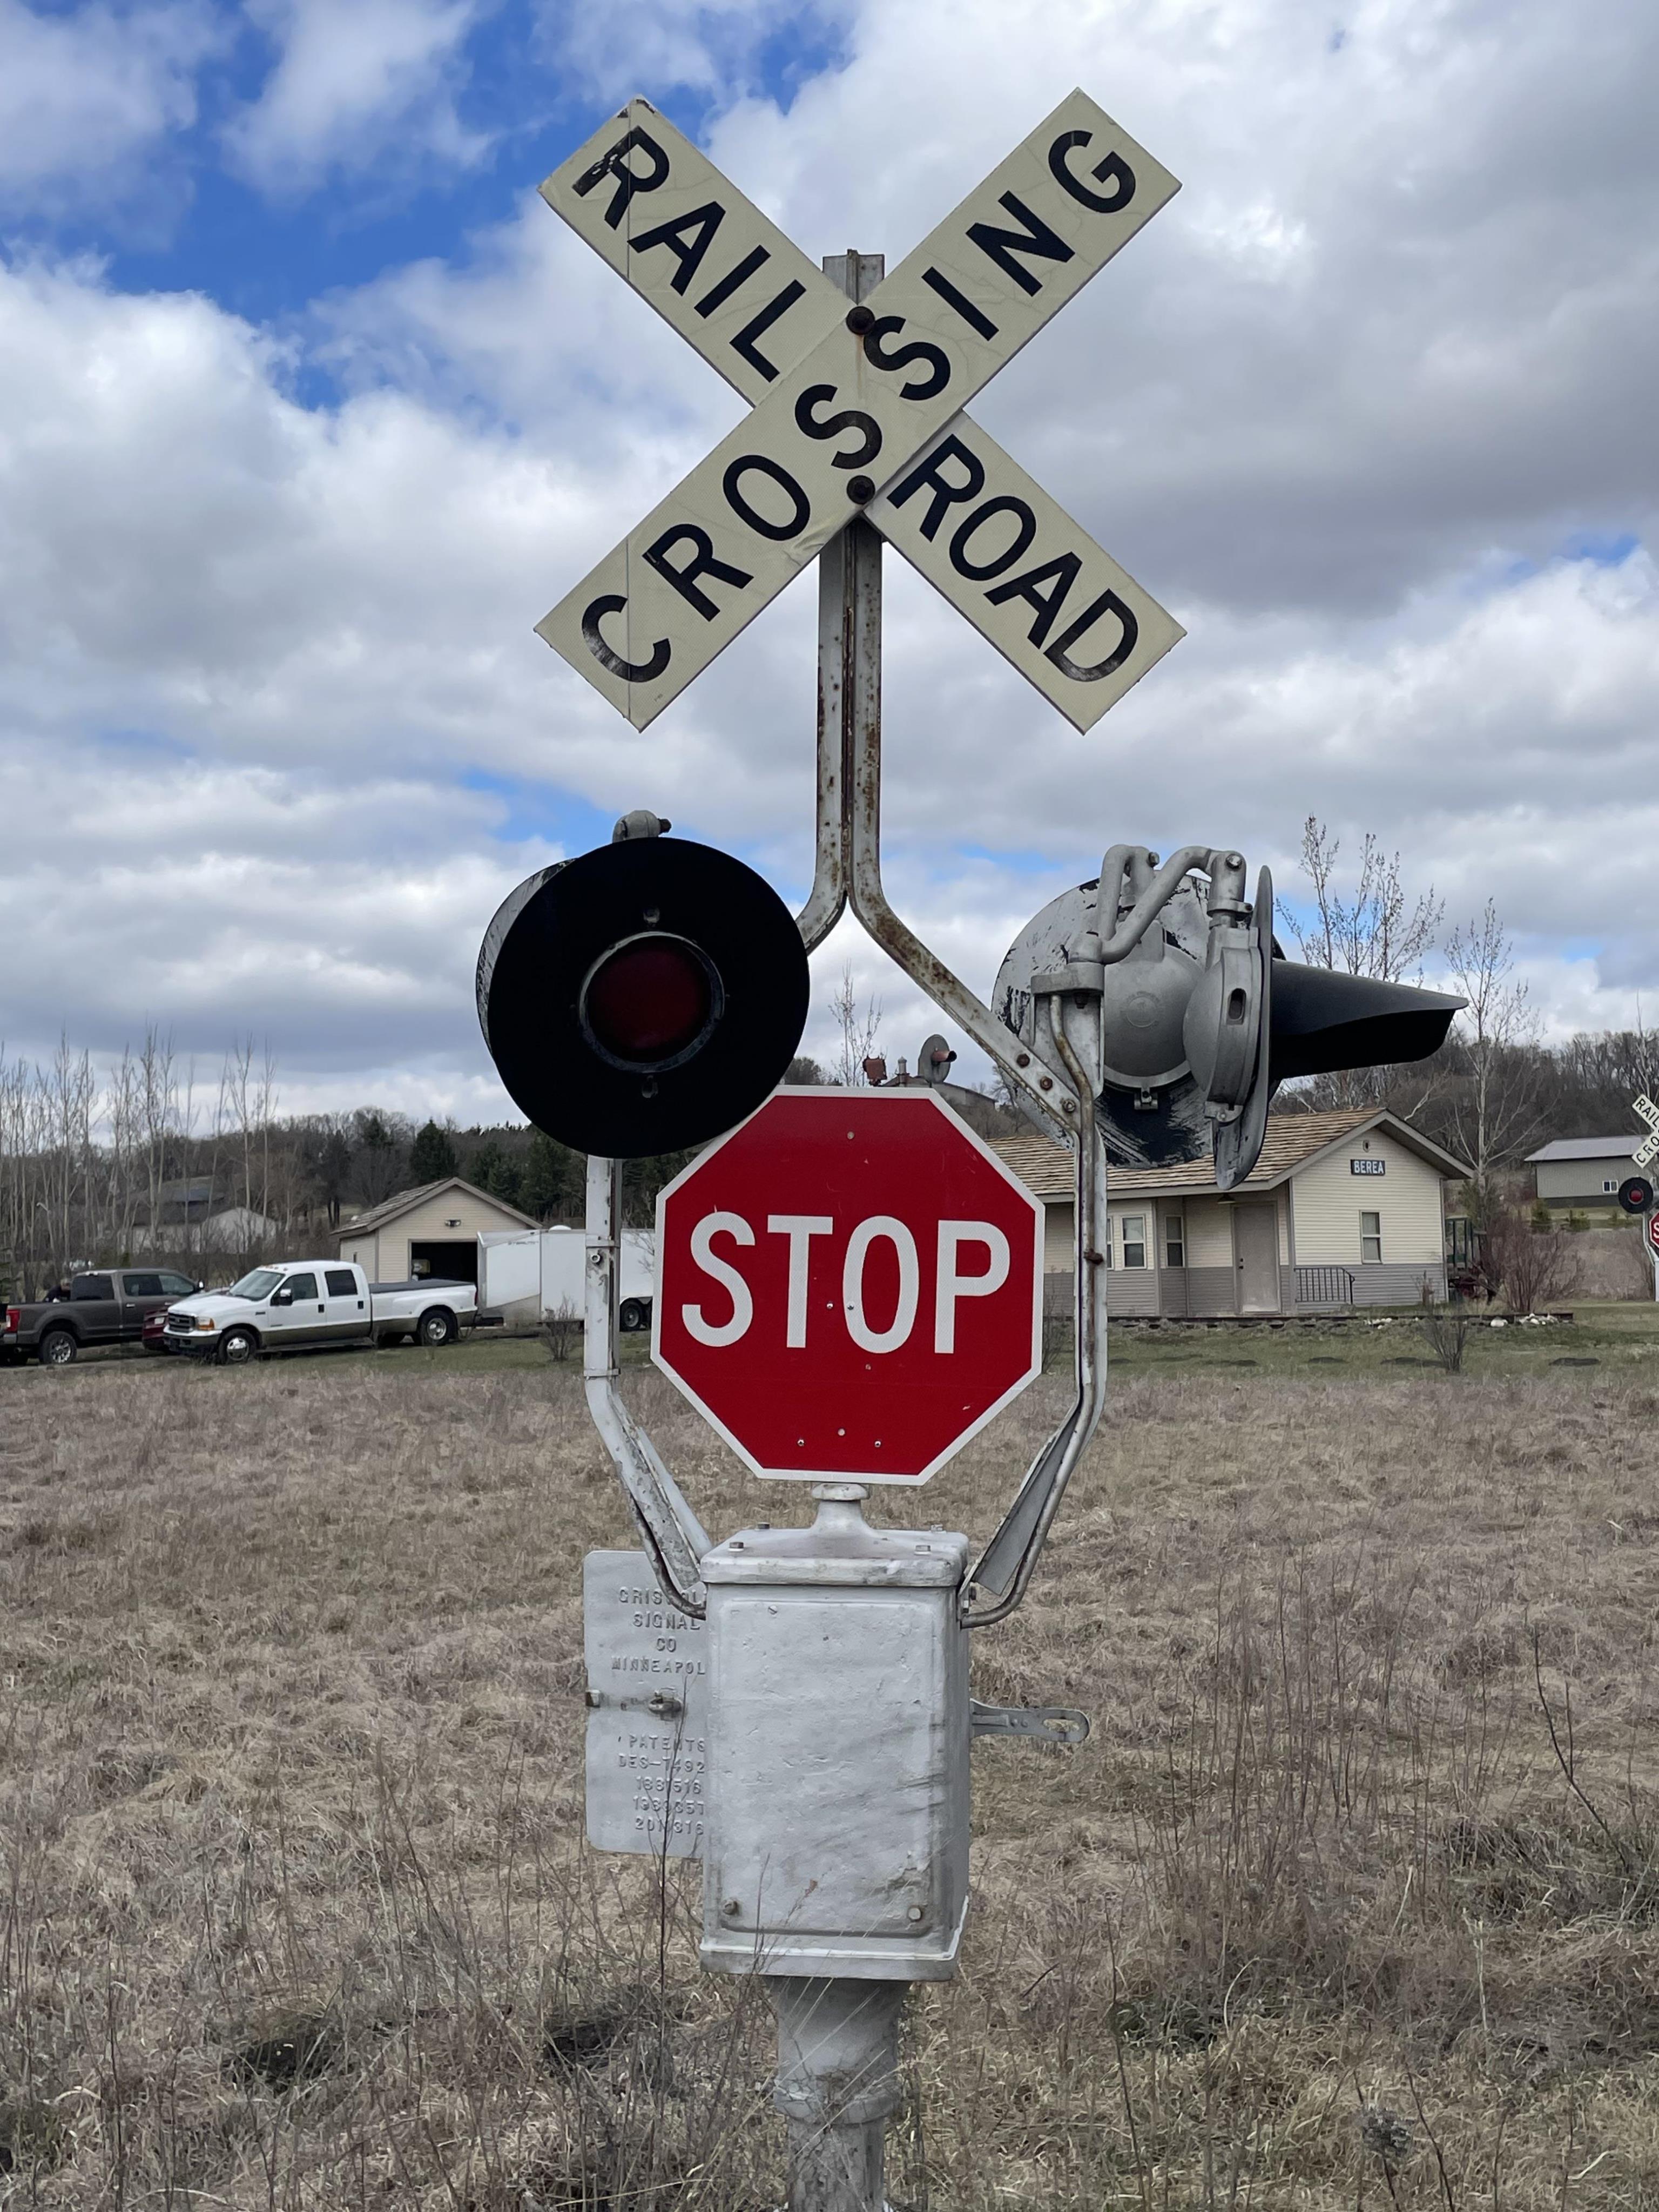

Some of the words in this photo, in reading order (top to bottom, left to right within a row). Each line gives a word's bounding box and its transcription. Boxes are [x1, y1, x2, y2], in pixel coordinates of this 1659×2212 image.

[572, 125, 806, 382] RAIL
[886, 434, 1138, 683] ROAD
[581, 130, 1136, 683] CROSSING
[1636, 1128, 1659, 1163] CRO
[1354, 1161, 1384, 1174] BEREA
[682, 1211, 1010, 1354] STOP
[632, 1610, 701, 1630] SIGNAL
[656, 1635, 677, 1653] CO
